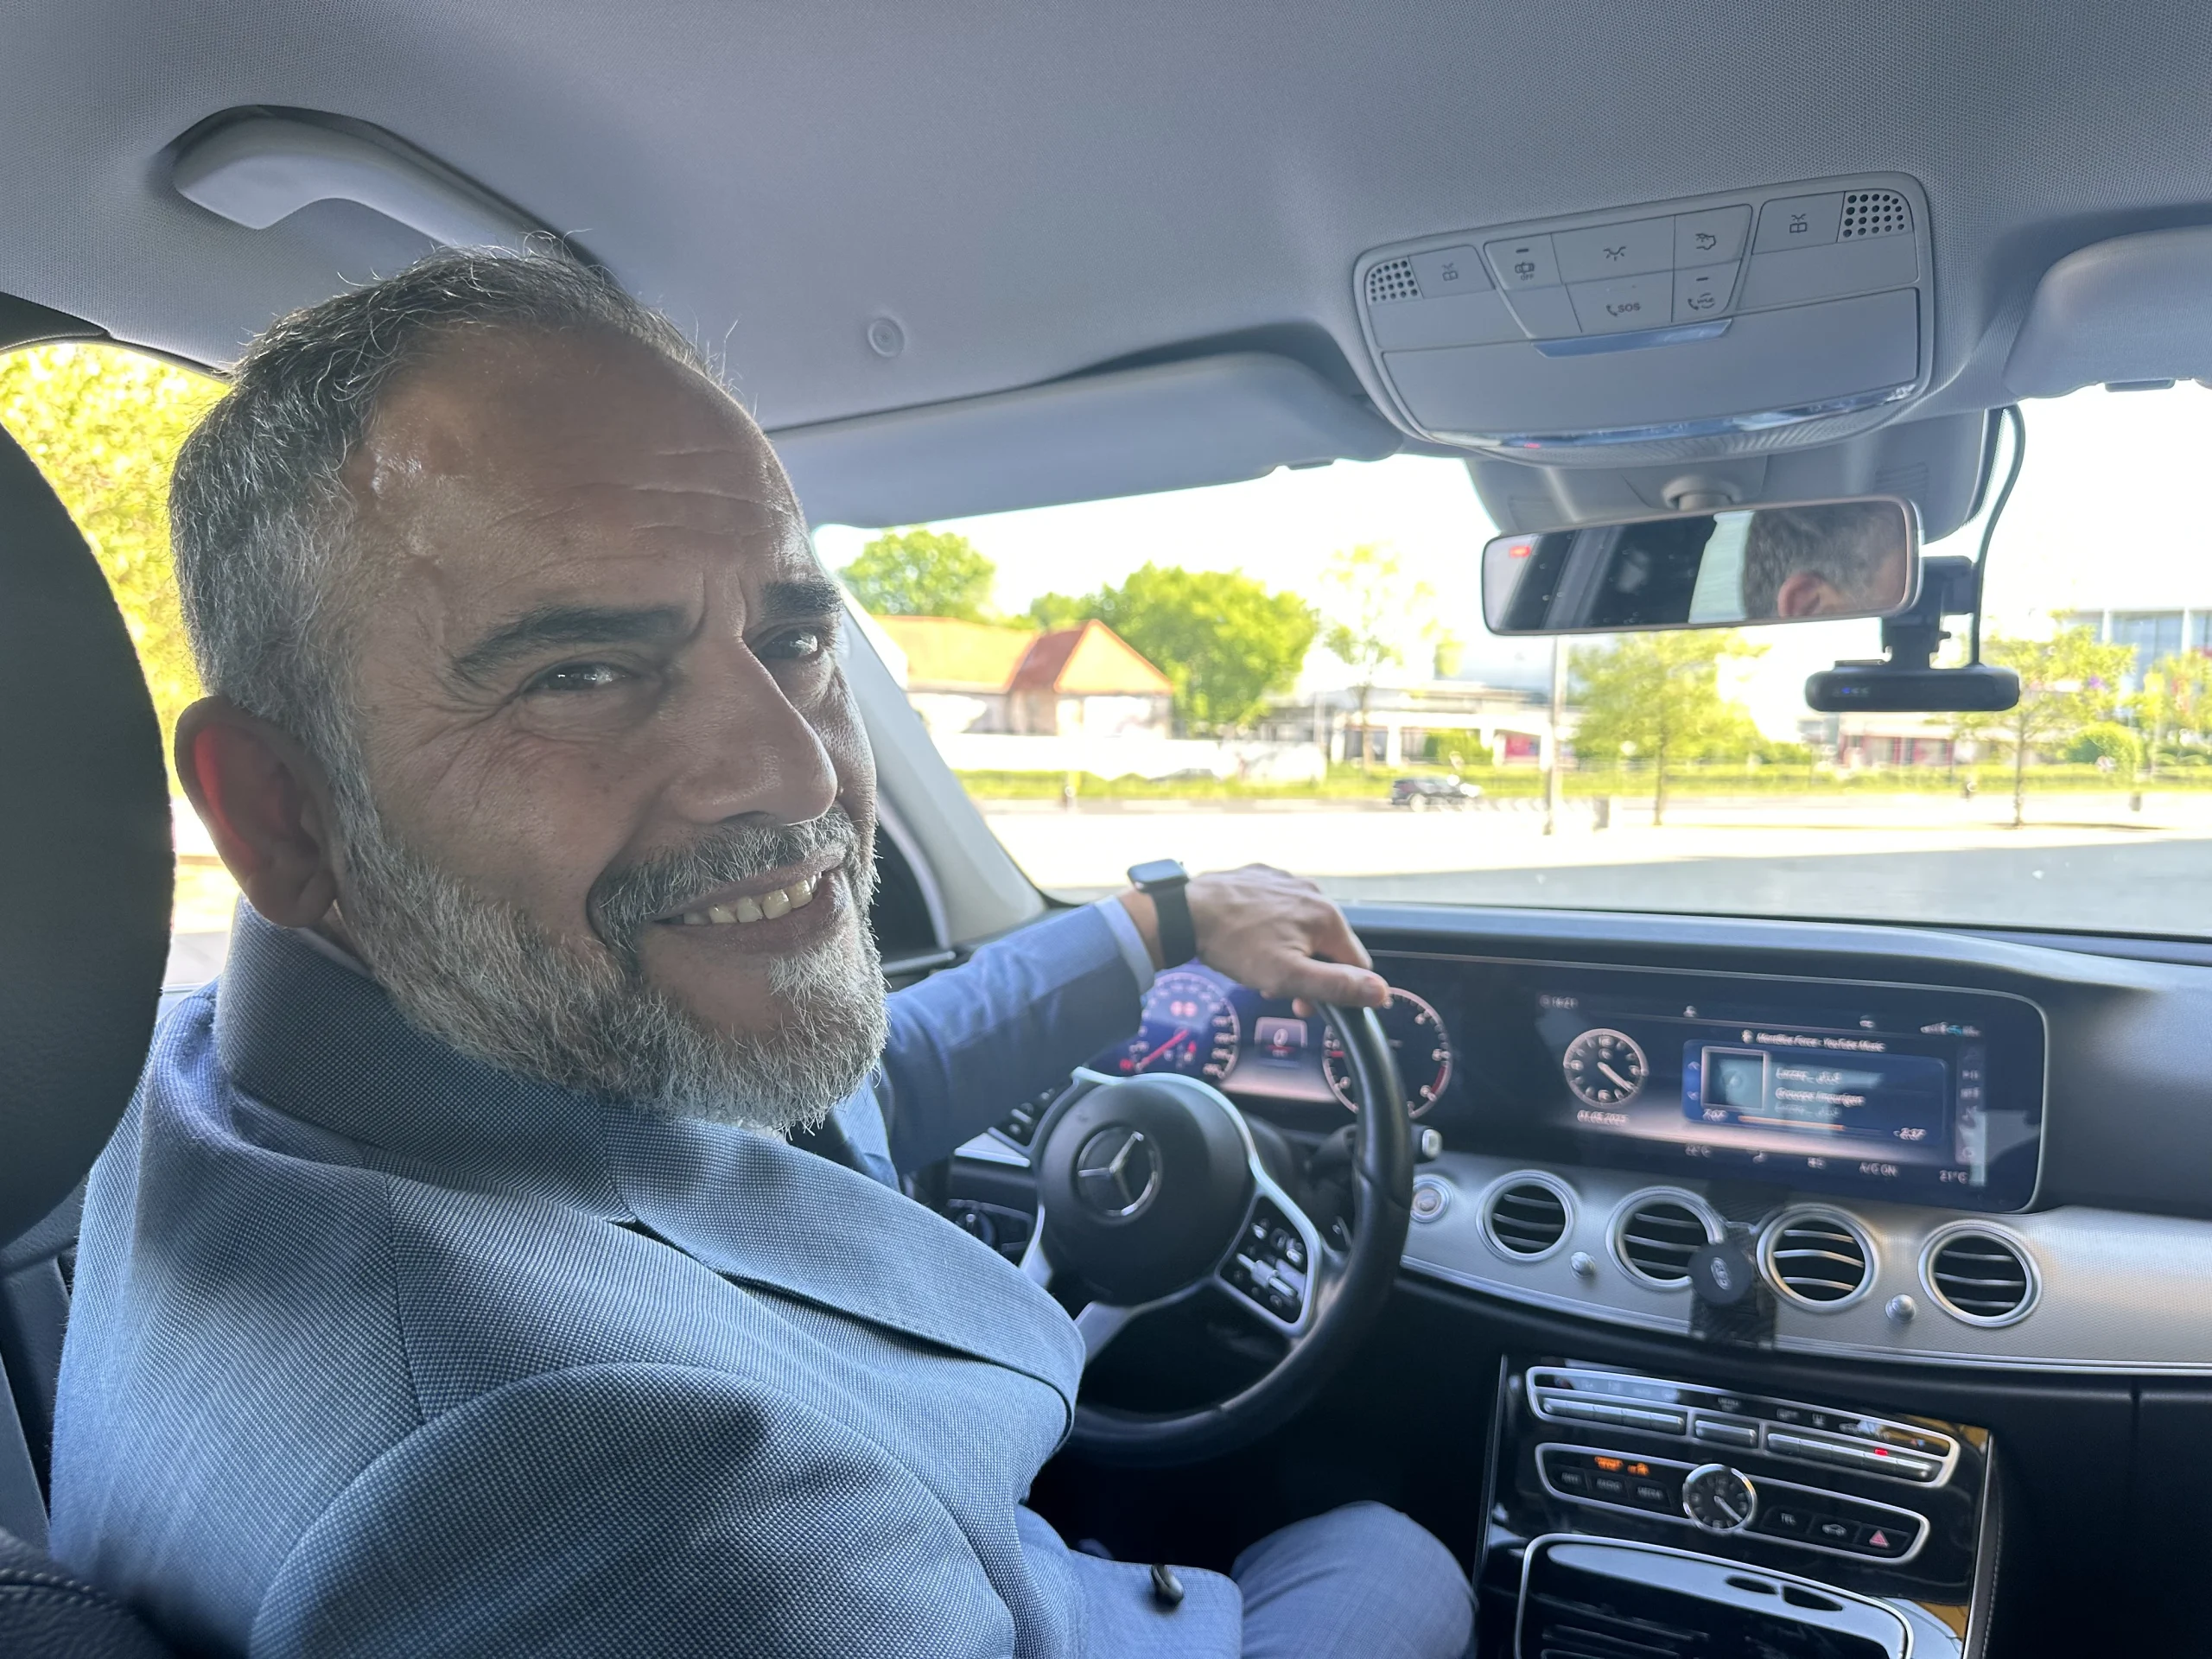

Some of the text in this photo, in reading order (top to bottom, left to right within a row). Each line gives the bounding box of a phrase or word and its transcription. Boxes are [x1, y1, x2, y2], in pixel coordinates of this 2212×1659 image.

[1618, 302, 1641, 314] SOS
[1859, 1162, 1899, 1177] A/C ON
[1939, 1170, 1968, 1184] 21°C
